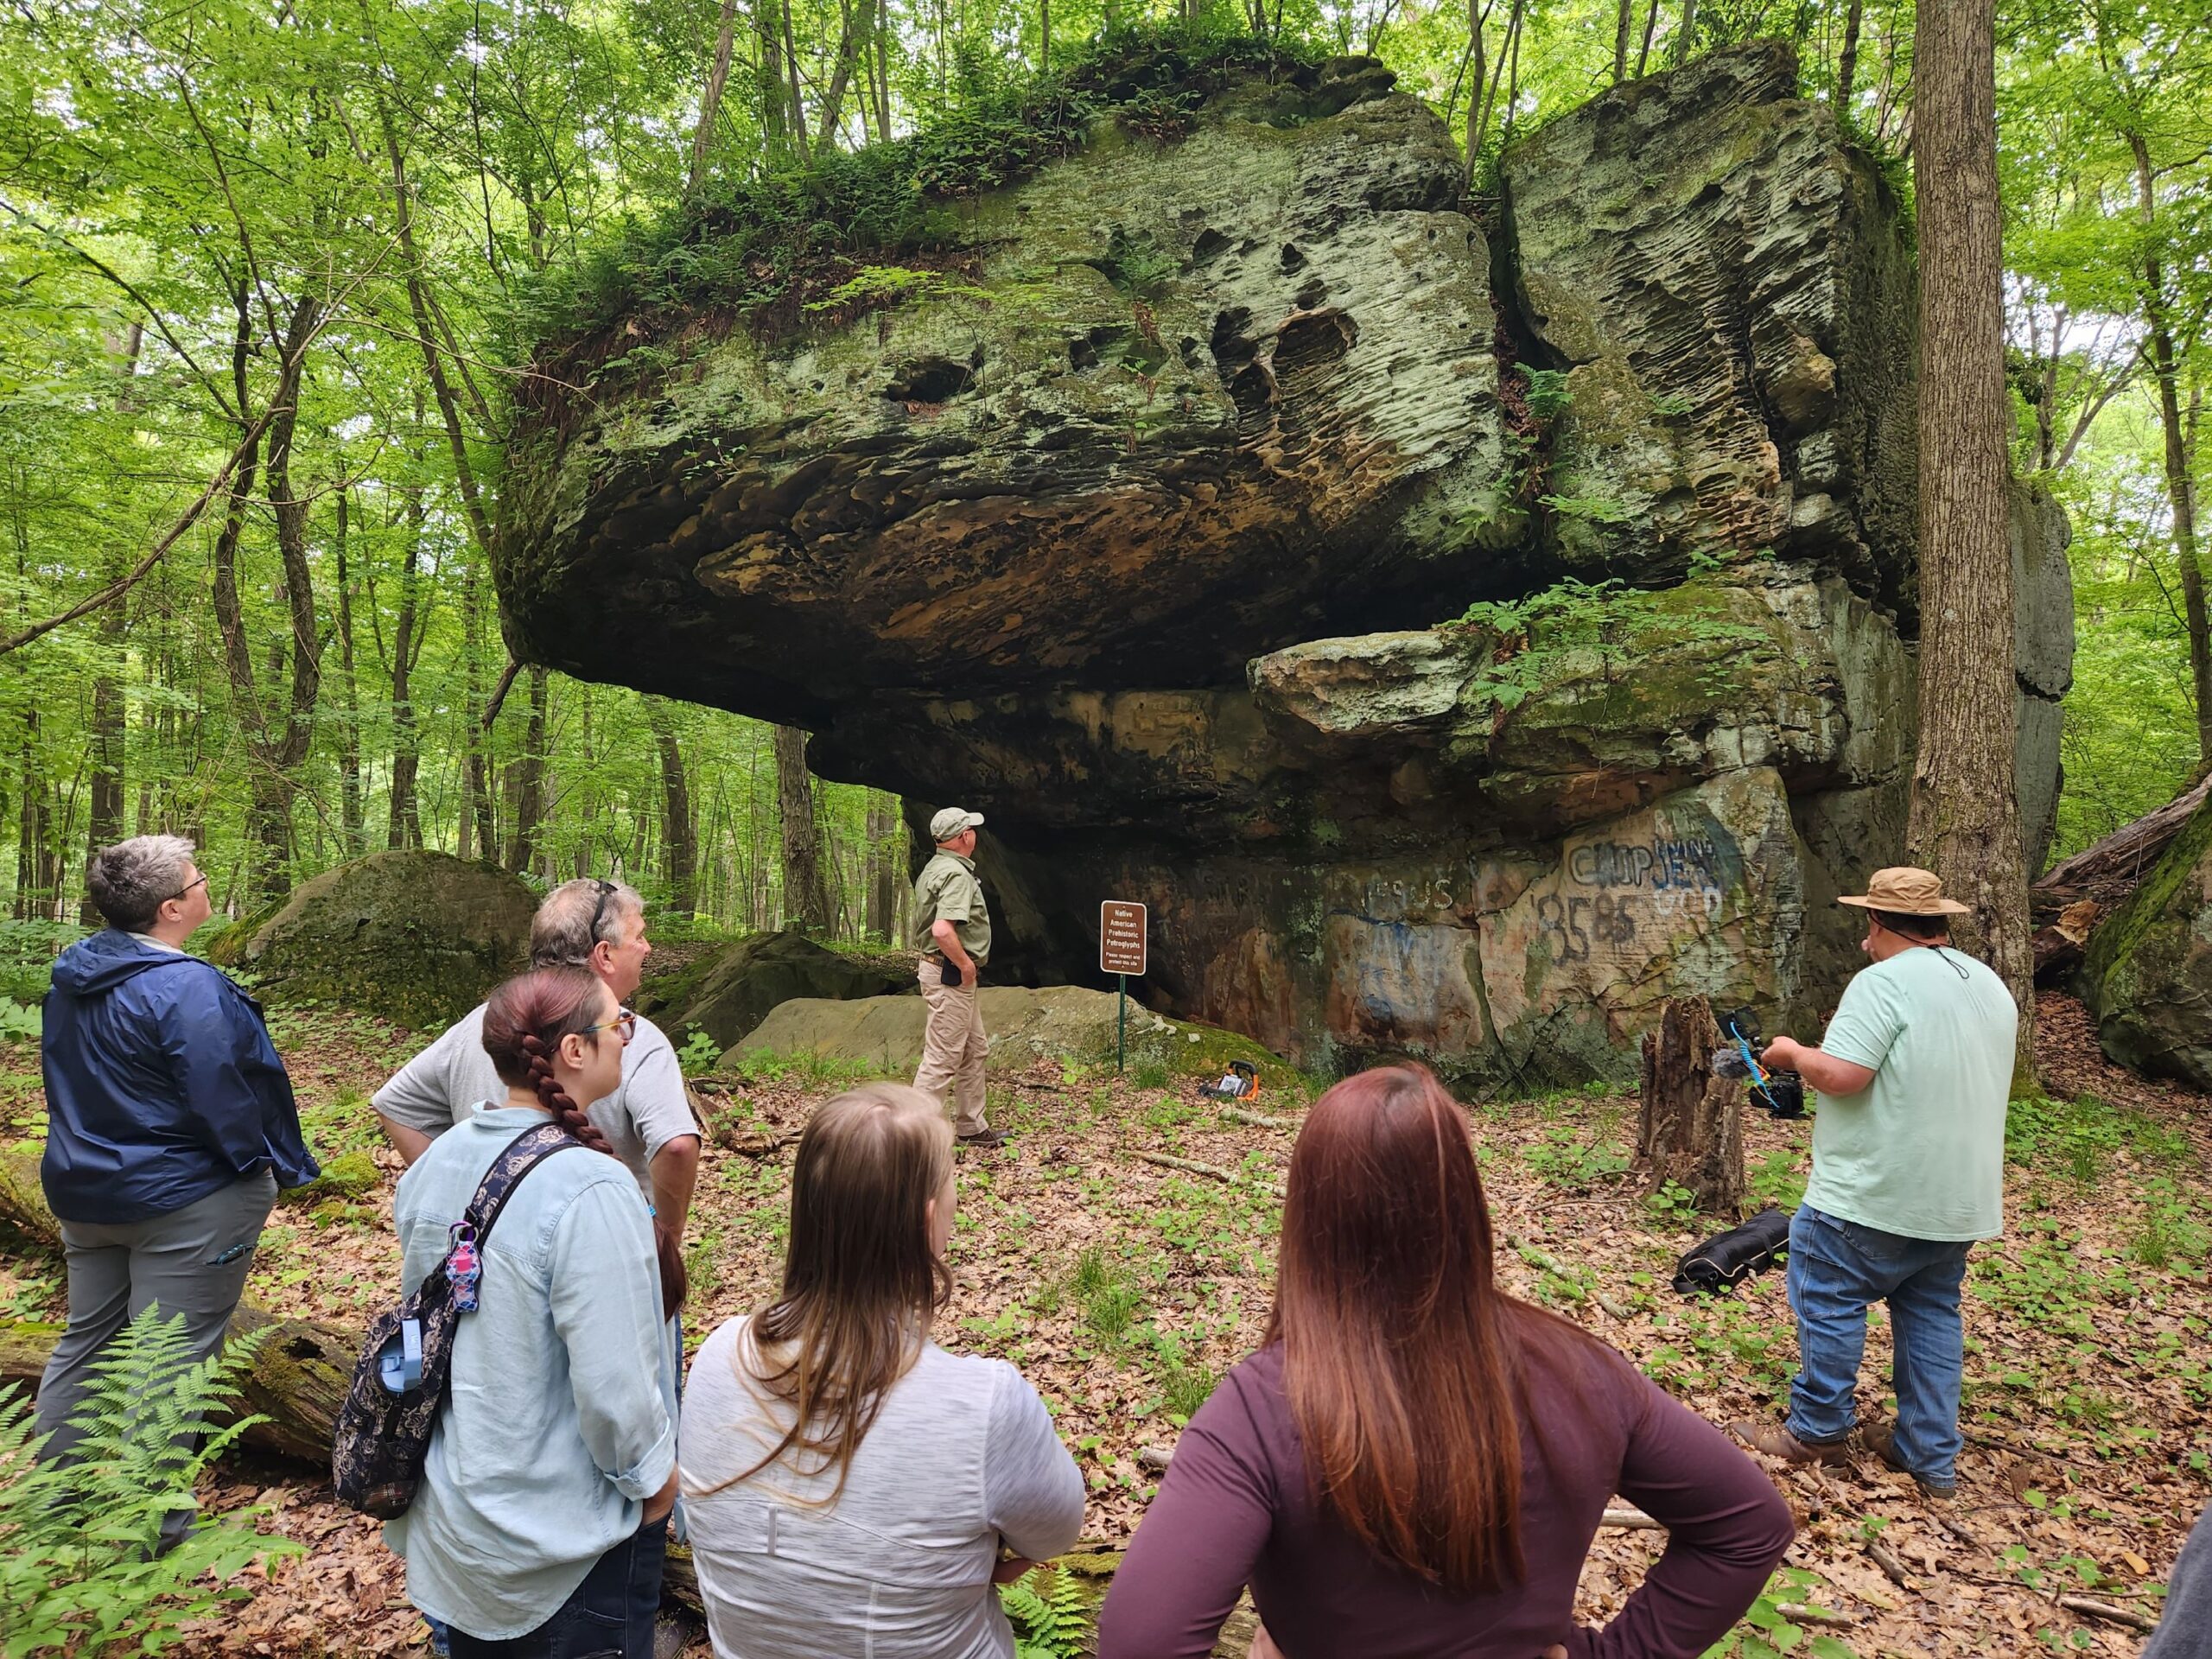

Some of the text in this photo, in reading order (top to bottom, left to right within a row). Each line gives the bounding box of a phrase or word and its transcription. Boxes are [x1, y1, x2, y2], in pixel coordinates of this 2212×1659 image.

[1115, 909, 1133, 918] Native
[1109, 919, 1137, 928] American
[1108, 929, 1139, 938] Prehistoric
[1106, 938, 1141, 949] Petroglyphs
